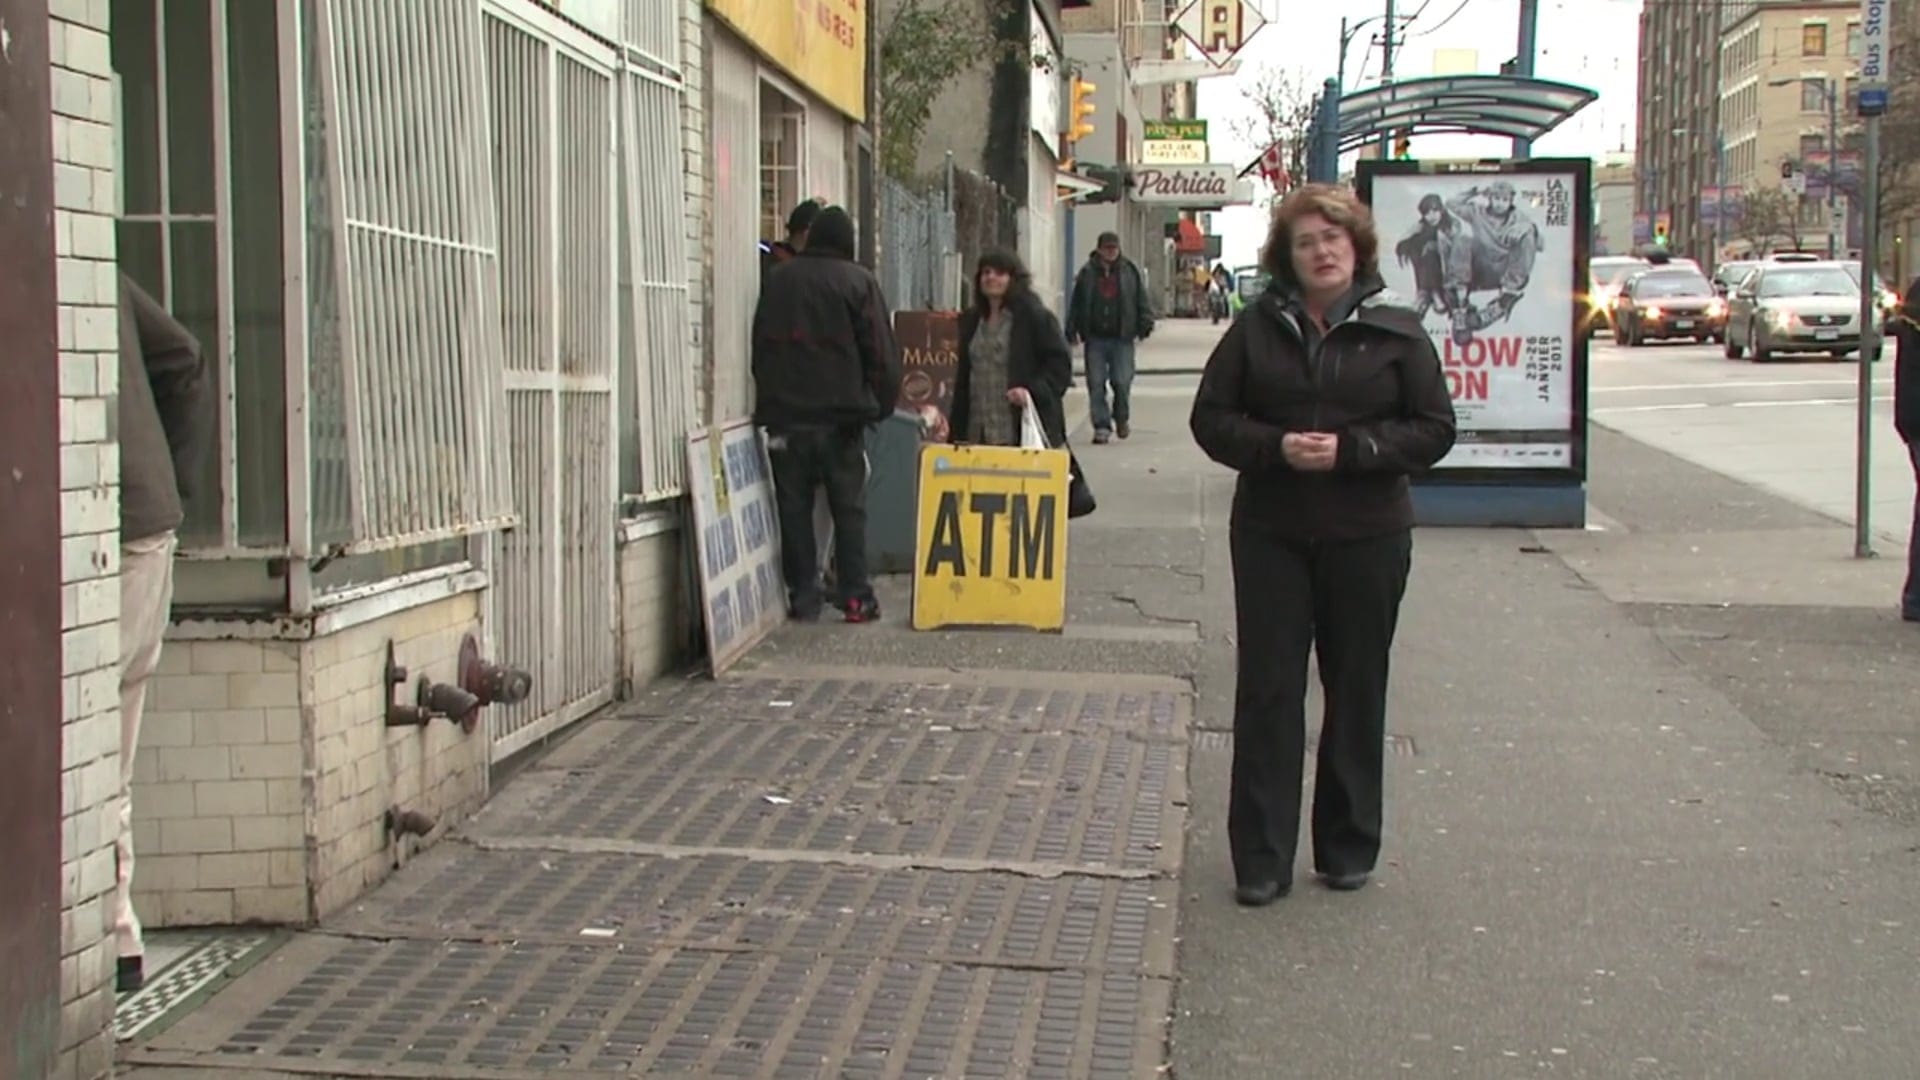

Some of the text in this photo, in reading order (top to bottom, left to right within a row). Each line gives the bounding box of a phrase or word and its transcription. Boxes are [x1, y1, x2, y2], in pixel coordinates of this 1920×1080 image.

[1863, 43, 1880, 76] Bus
[1137, 169, 1226, 197] Patricia
[1546, 179, 1563, 190] LA
[1546, 191, 1569, 202] SEI
[1546, 215, 1569, 227] ME
[902, 346, 959, 366] MAGN
[1443, 336, 1522, 367] LOW
[1525, 335, 1537, 381] 23-26
[1550, 335, 1562, 372] 2013
[1538, 335, 1549, 403] JANVIER
[1444, 370, 1489, 400] ON
[924, 490, 1057, 580] ATM
